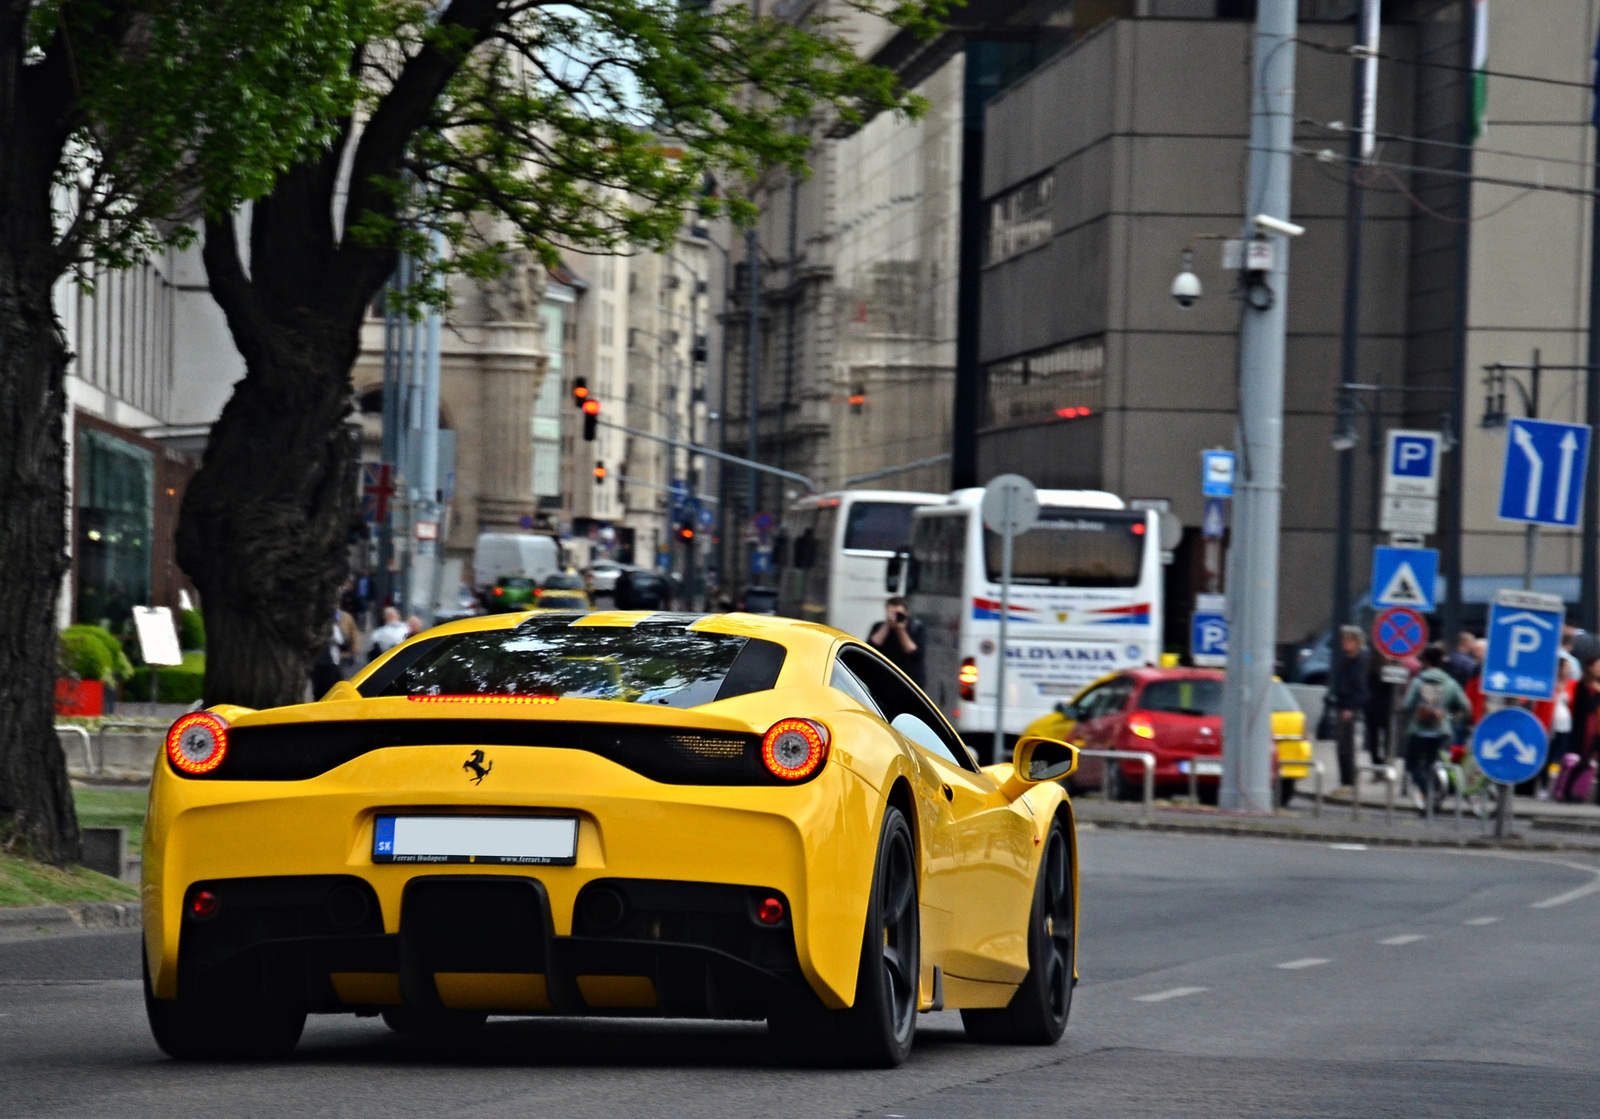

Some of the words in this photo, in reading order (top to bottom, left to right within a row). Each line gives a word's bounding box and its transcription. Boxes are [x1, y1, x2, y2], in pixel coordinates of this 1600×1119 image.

[1398, 442, 1427, 470] P
[1507, 624, 1542, 668] P
[1004, 647, 1116, 662] SLOVAKIA
[378, 841, 391, 851] SK
[393, 854, 416, 862] Ferrari
[417, 855, 448, 863] Budapest
